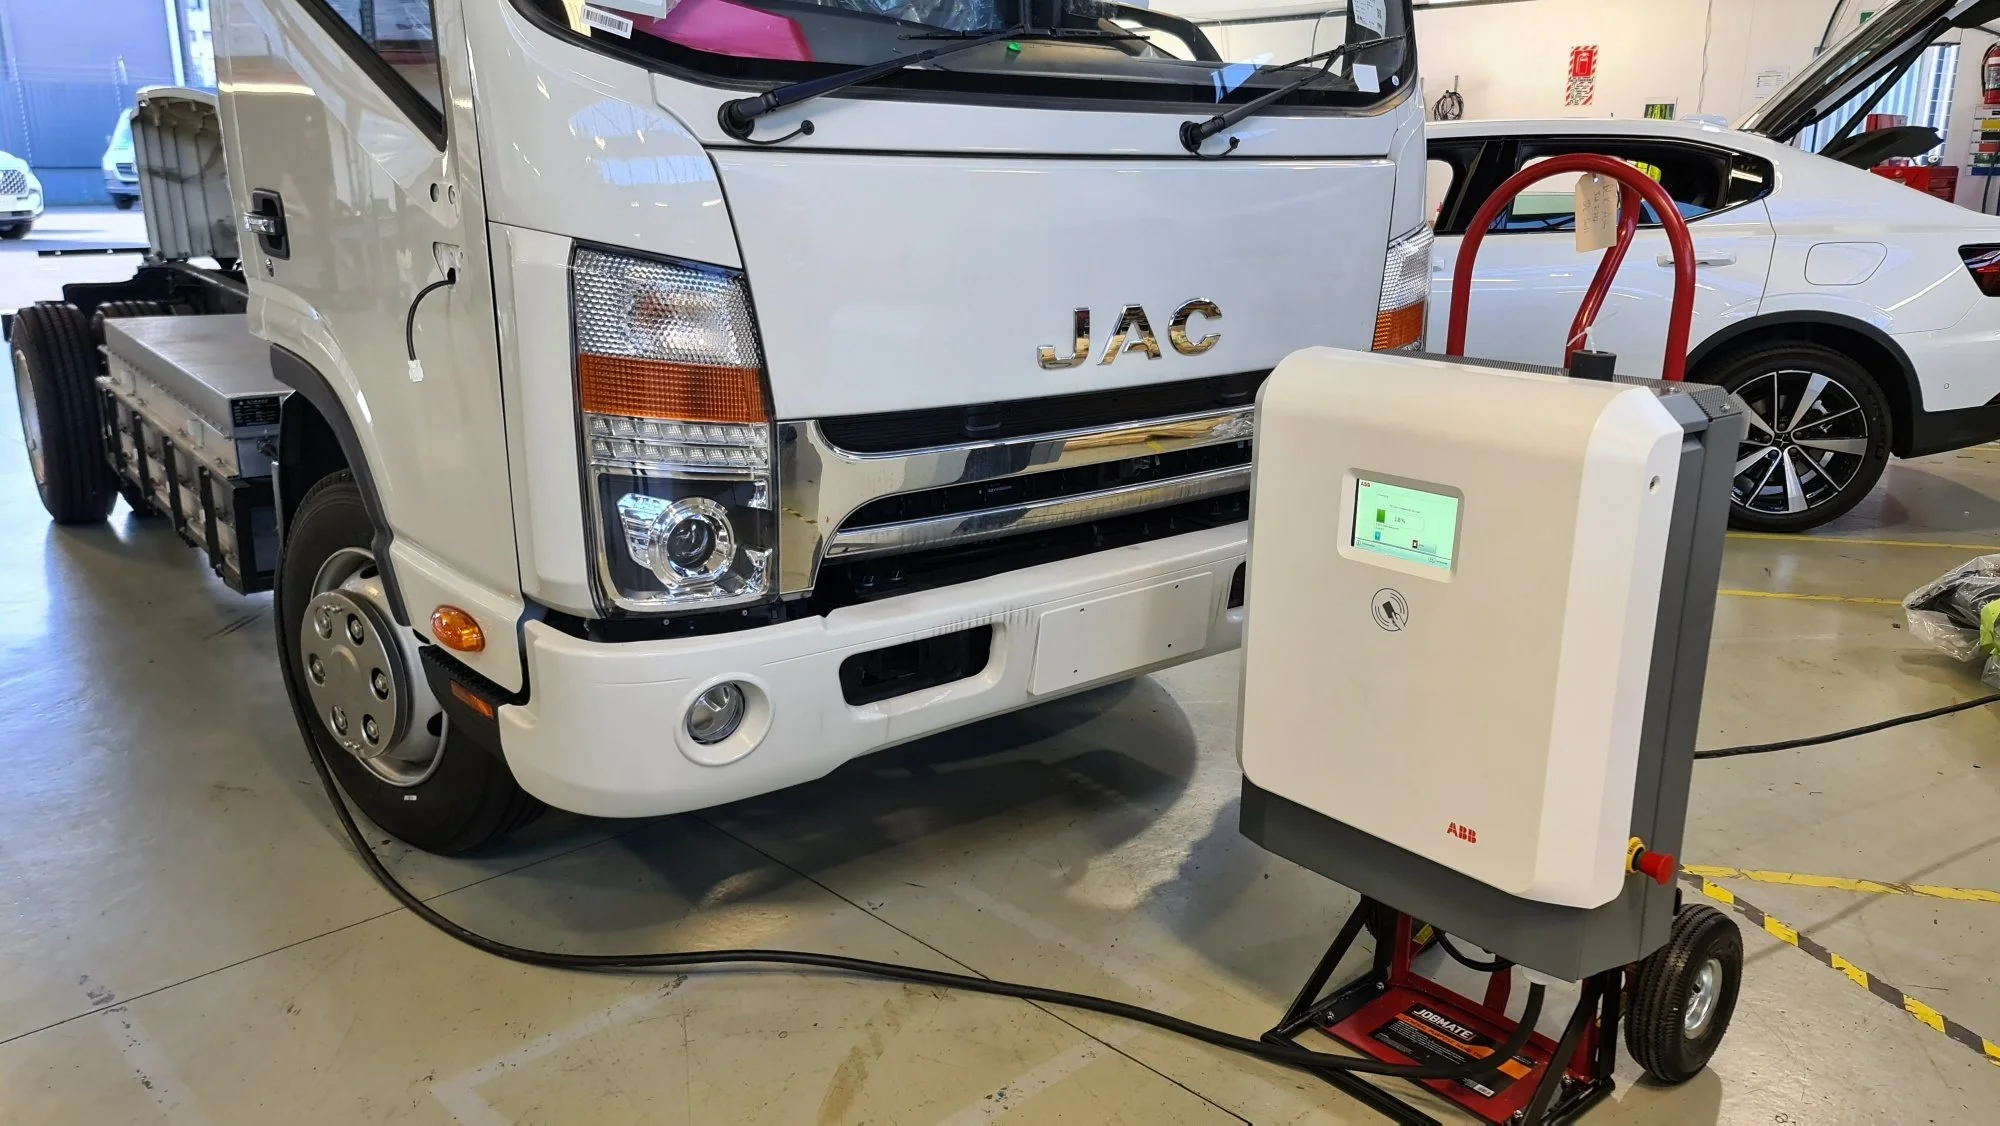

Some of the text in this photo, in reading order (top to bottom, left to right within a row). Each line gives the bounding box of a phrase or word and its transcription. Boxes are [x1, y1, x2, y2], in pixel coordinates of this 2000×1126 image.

[1037, 297, 1222, 369] JAC
[1446, 821, 1477, 844] ABB
[1413, 1009, 1474, 1039] JOBMATE
